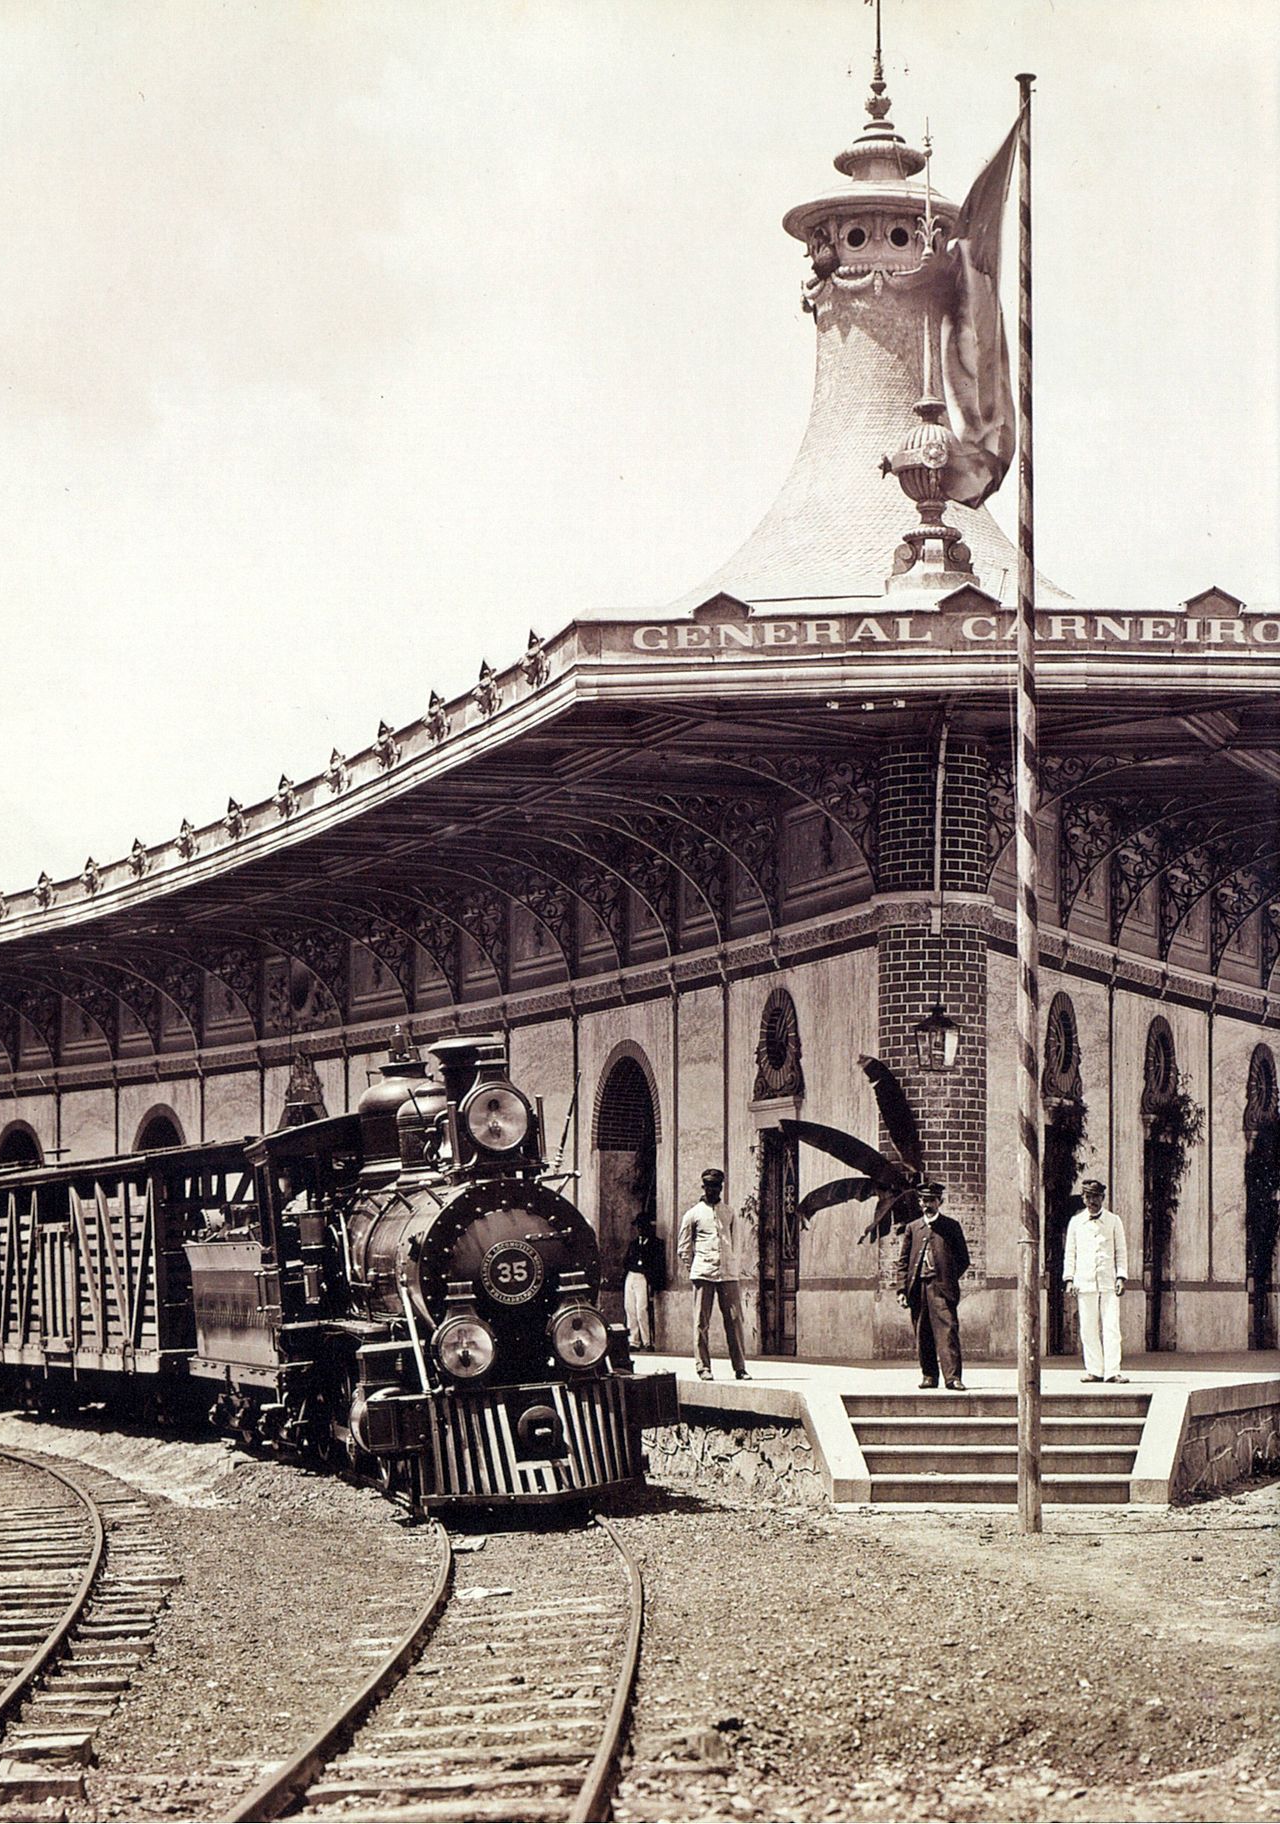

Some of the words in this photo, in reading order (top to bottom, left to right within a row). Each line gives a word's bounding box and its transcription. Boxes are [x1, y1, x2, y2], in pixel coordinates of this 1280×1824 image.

[632, 617, 932, 650] GENERAL
[961, 615, 1280, 645] CARNEIRO
[497, 1260, 528, 1283] 35
